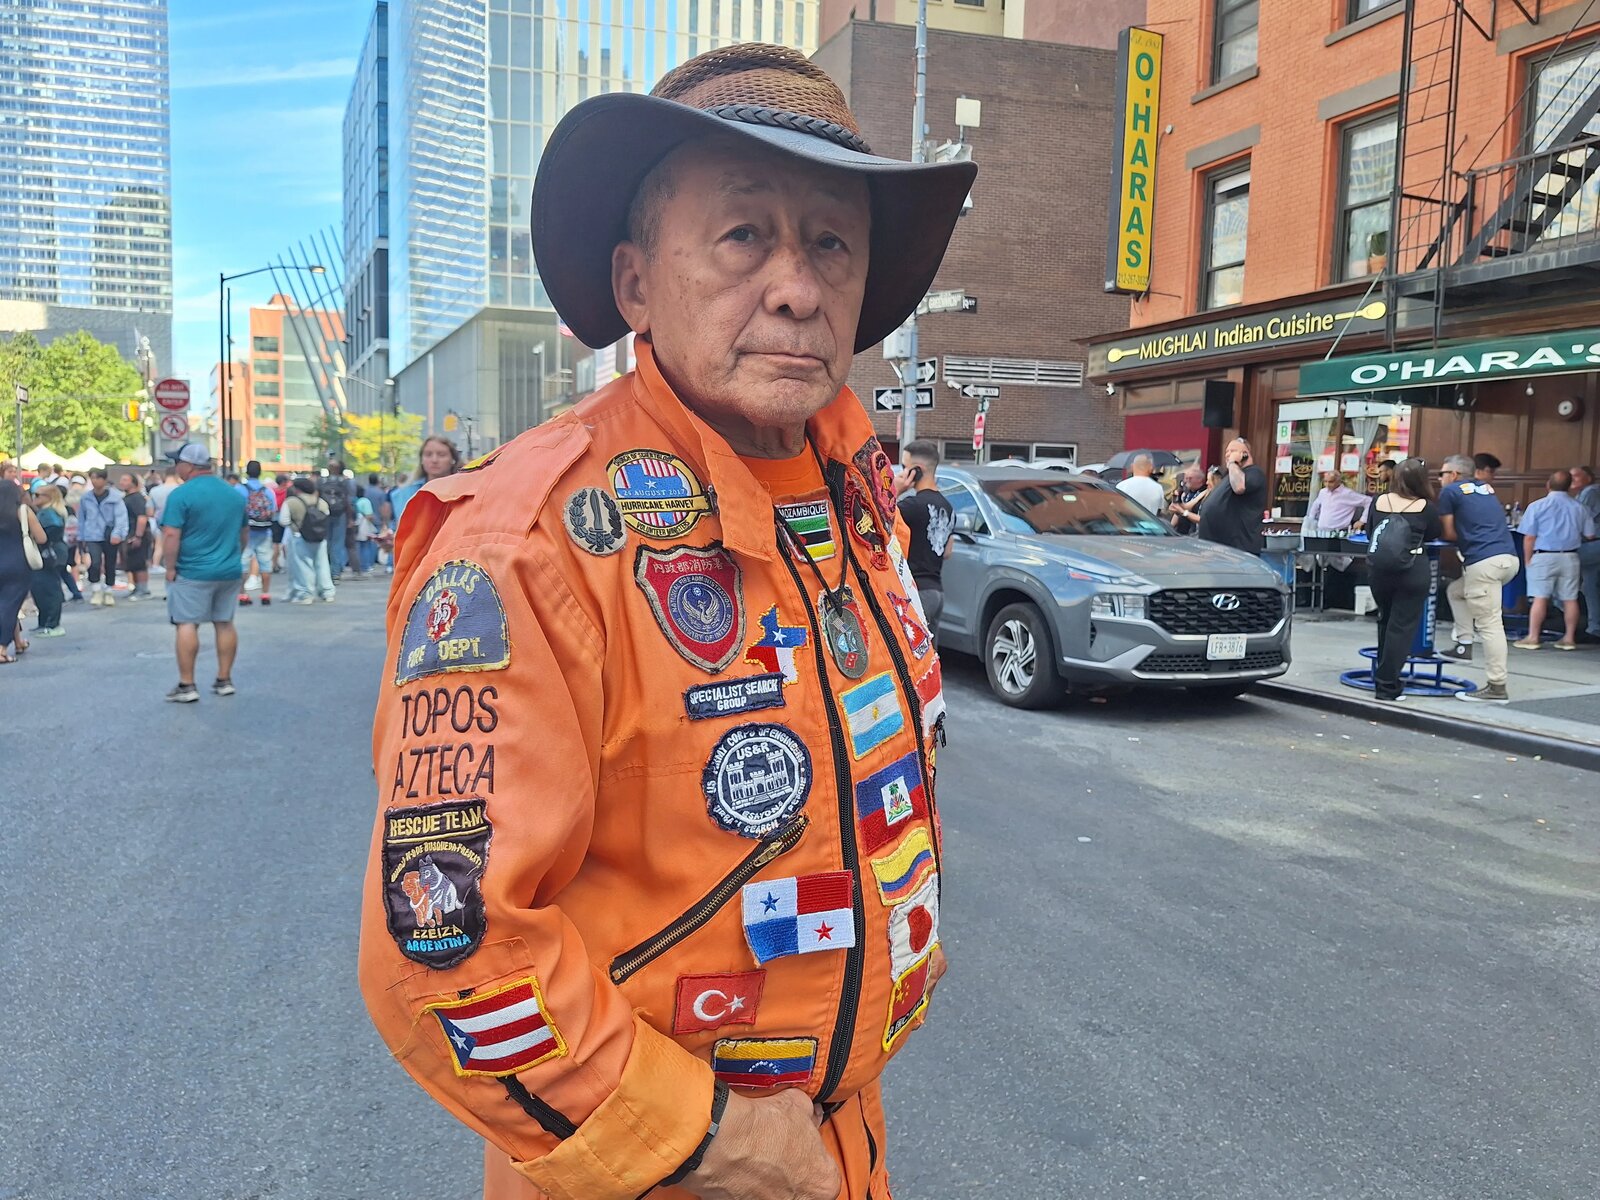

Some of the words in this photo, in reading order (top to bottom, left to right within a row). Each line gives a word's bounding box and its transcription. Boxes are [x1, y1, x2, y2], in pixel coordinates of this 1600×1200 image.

[1139, 330, 1206, 360] MUGHLAI
[1214, 324, 1263, 348] Indian
[1266, 312, 1334, 339] Cuisine
[883, 395, 901, 404] ONE
[620, 500, 664, 511] HURRICANE
[665, 499, 694, 509] HARVEY
[425, 567, 480, 603] DALLAS
[1425, 596, 1437, 646] LIGHT
[438, 637, 486, 660] DEPT.
[689, 684, 744, 705] SPECIALIST
[745, 679, 778, 694] SEARCH
[717, 696, 747, 711] GROUP
[402, 685, 498, 739] TOPOS
[706, 780, 717, 794] US
[769, 728, 806, 763] ENGINEERS
[736, 742, 770, 760] US&R
[391, 742, 495, 801] AZTECA
[390, 814, 441, 838] RESCUE
[441, 806, 484, 831] TEAM
[406, 934, 472, 952] ARGENTINA
[413, 924, 463, 940] EZEIZA
